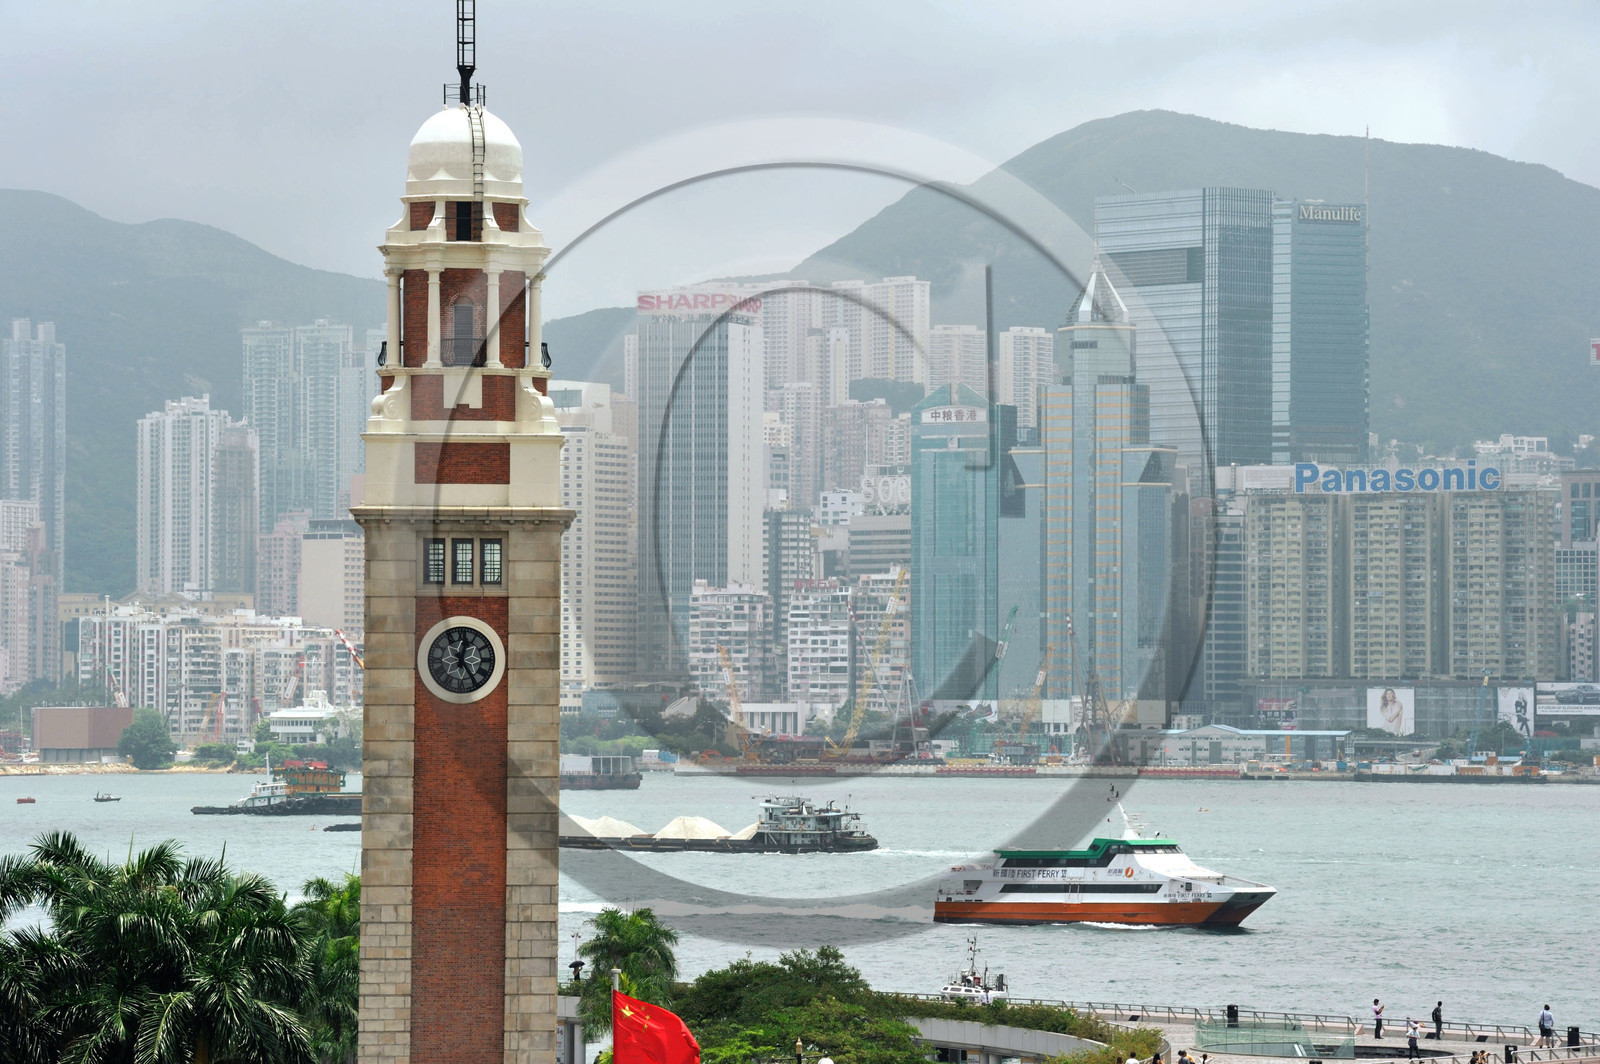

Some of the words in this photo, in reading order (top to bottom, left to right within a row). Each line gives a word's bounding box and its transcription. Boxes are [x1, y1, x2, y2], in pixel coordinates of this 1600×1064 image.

[1299, 205, 1361, 221] Manulife
[637, 293, 727, 311] SHARP
[930, 409, 977, 422] 中粮香港
[1294, 459, 1502, 493] Panasonic
[1016, 869, 1037, 878] FIRST
[1037, 869, 1060, 878] FERRY
